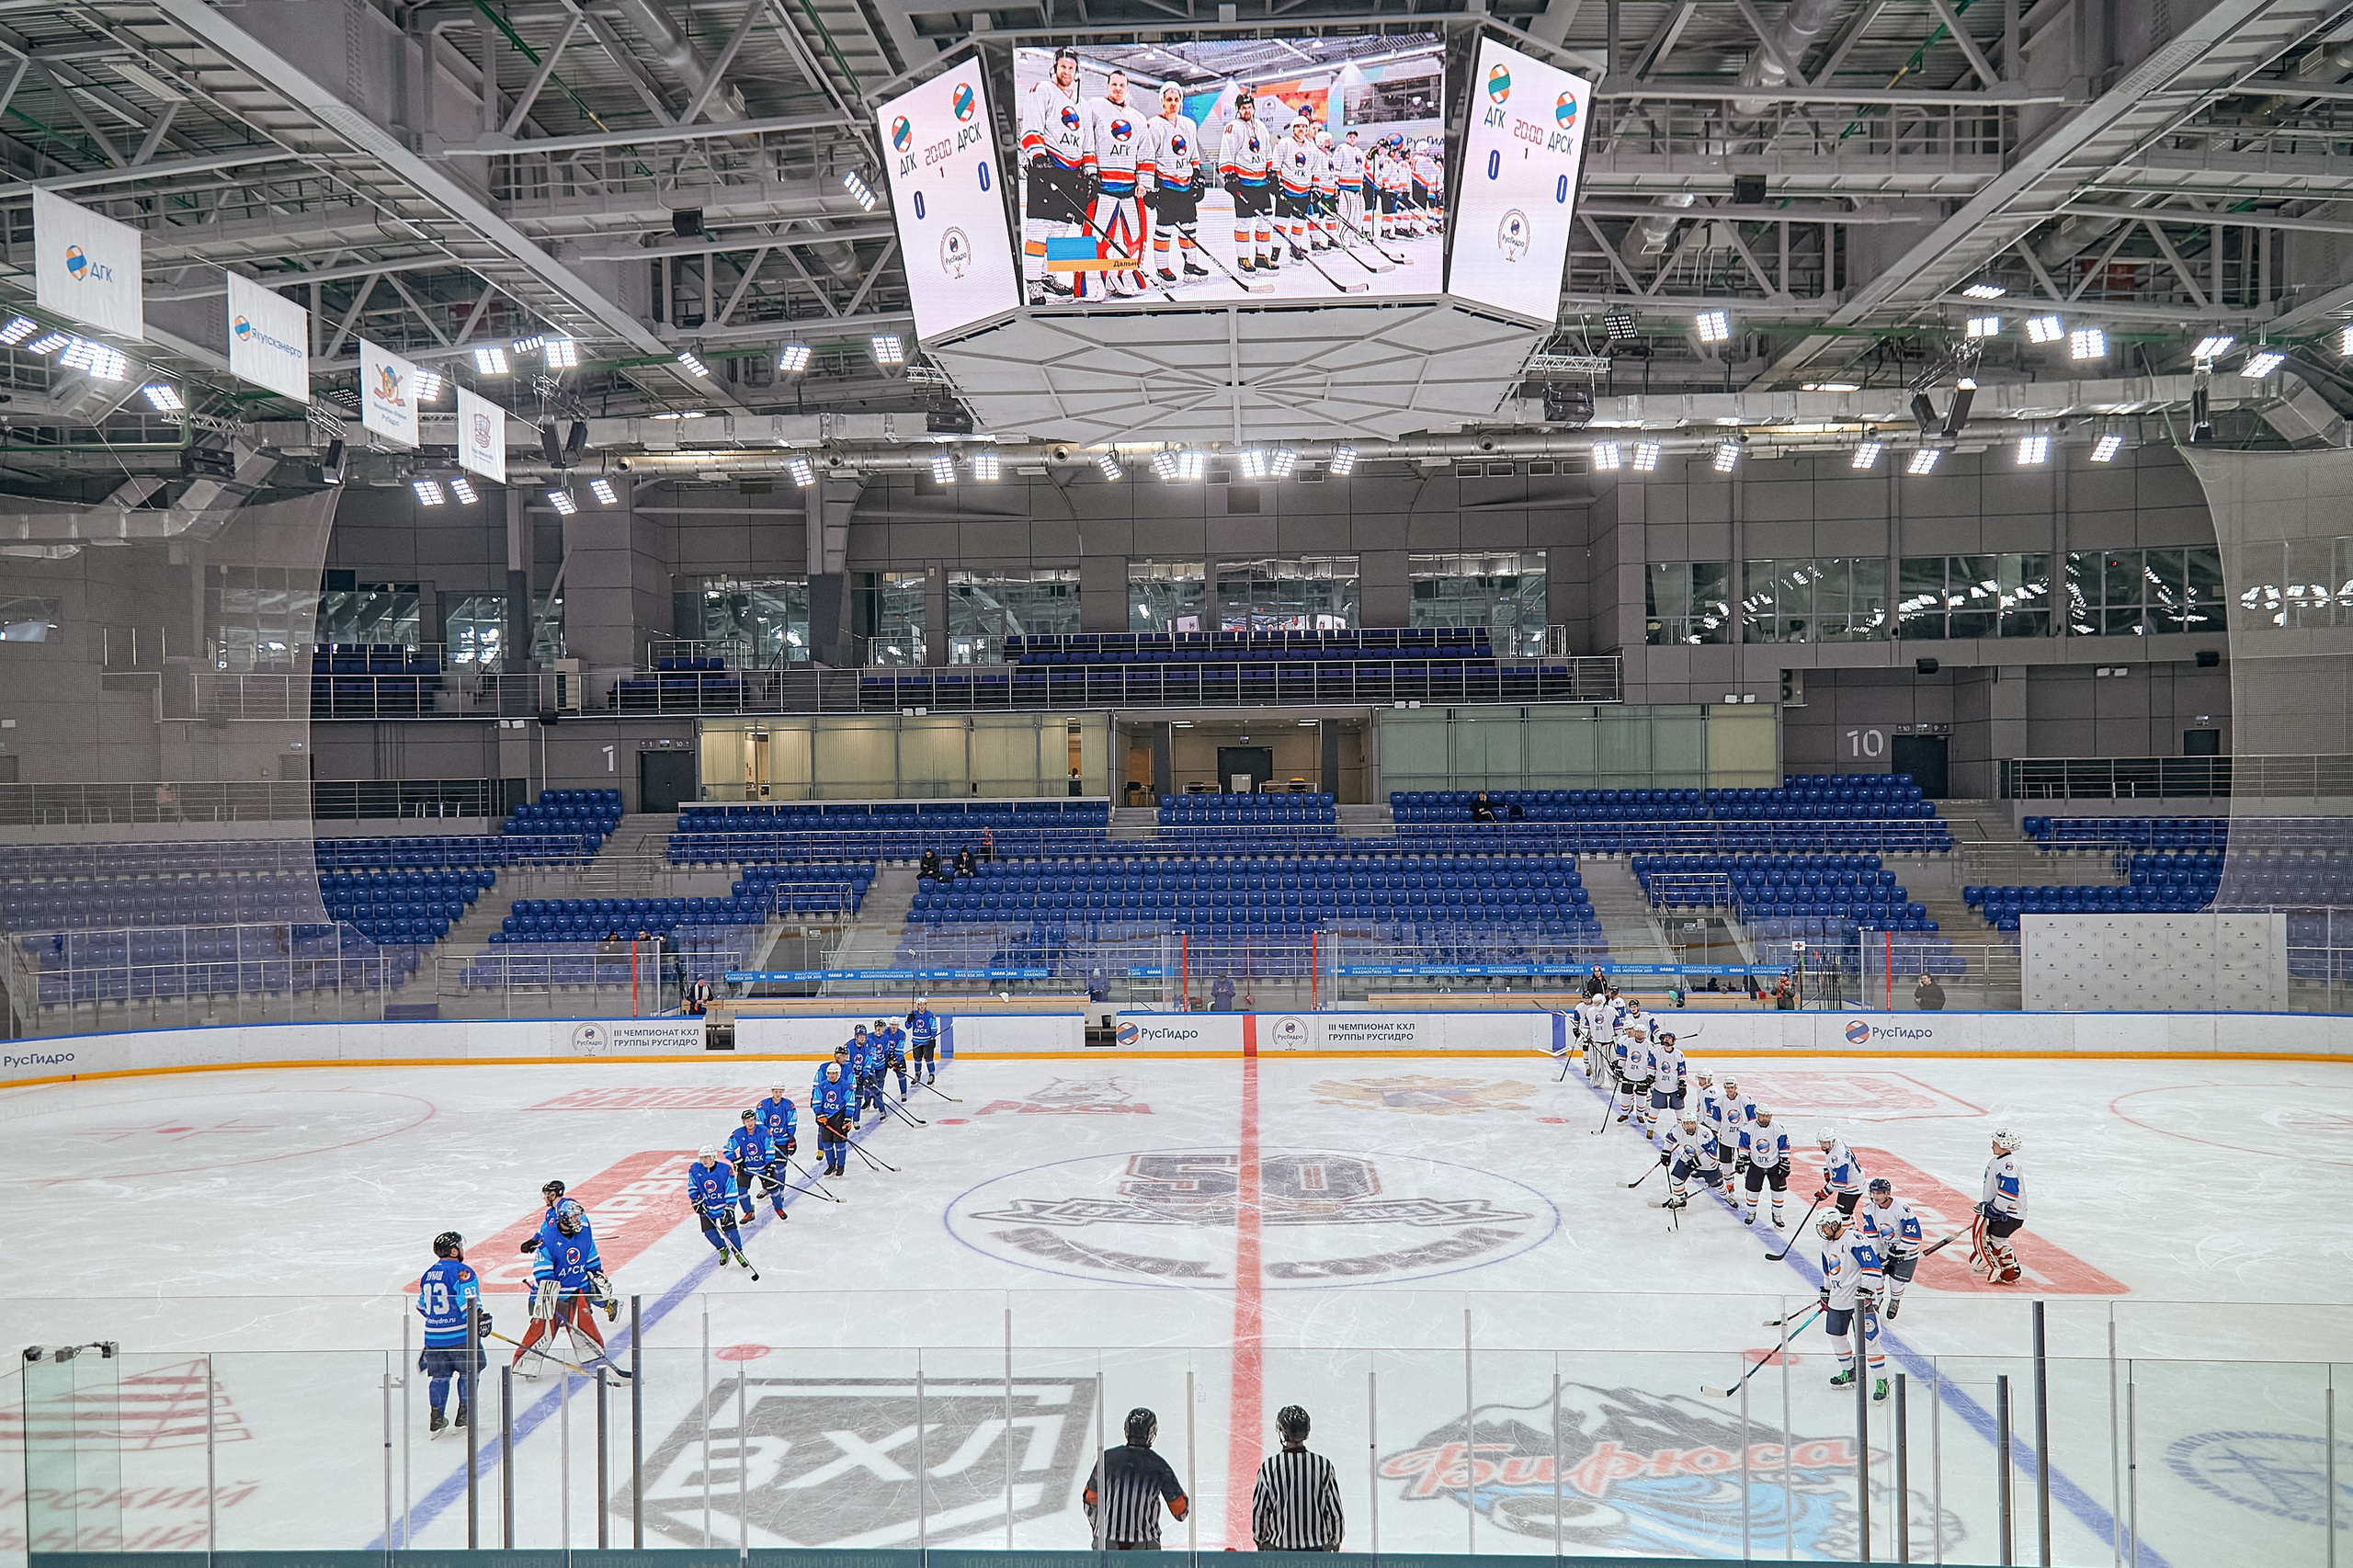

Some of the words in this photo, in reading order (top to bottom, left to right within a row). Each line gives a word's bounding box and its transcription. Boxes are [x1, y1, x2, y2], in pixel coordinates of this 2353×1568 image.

[1484, 105, 1506, 129] ДГК
[1514, 119, 1543, 145] 20:00
[900, 152, 918, 179] ДГК
[925, 139, 953, 166] 20:00
[1487, 149, 1501, 180] 0
[1524, 147, 1529, 159] 1
[939, 165, 945, 178] 1
[978, 162, 991, 192] 0
[1556, 175, 1568, 204] 0
[914, 191, 926, 220] 0
[90, 262, 113, 283] ДГК
[252, 327, 302, 358] Якутскэнерго
[1847, 730, 1884, 756] 10
[603, 744, 614, 772] 1
[1142, 1028, 1199, 1040] РусГидро
[1872, 1028, 1933, 1040] РусГидро
[4, 1053, 75, 1068] РусГидро
[1117, 1154, 1382, 1201] 50
[1860, 1251, 1872, 1261] 16
[643, 1414, 1065, 1501] ВХЛ
